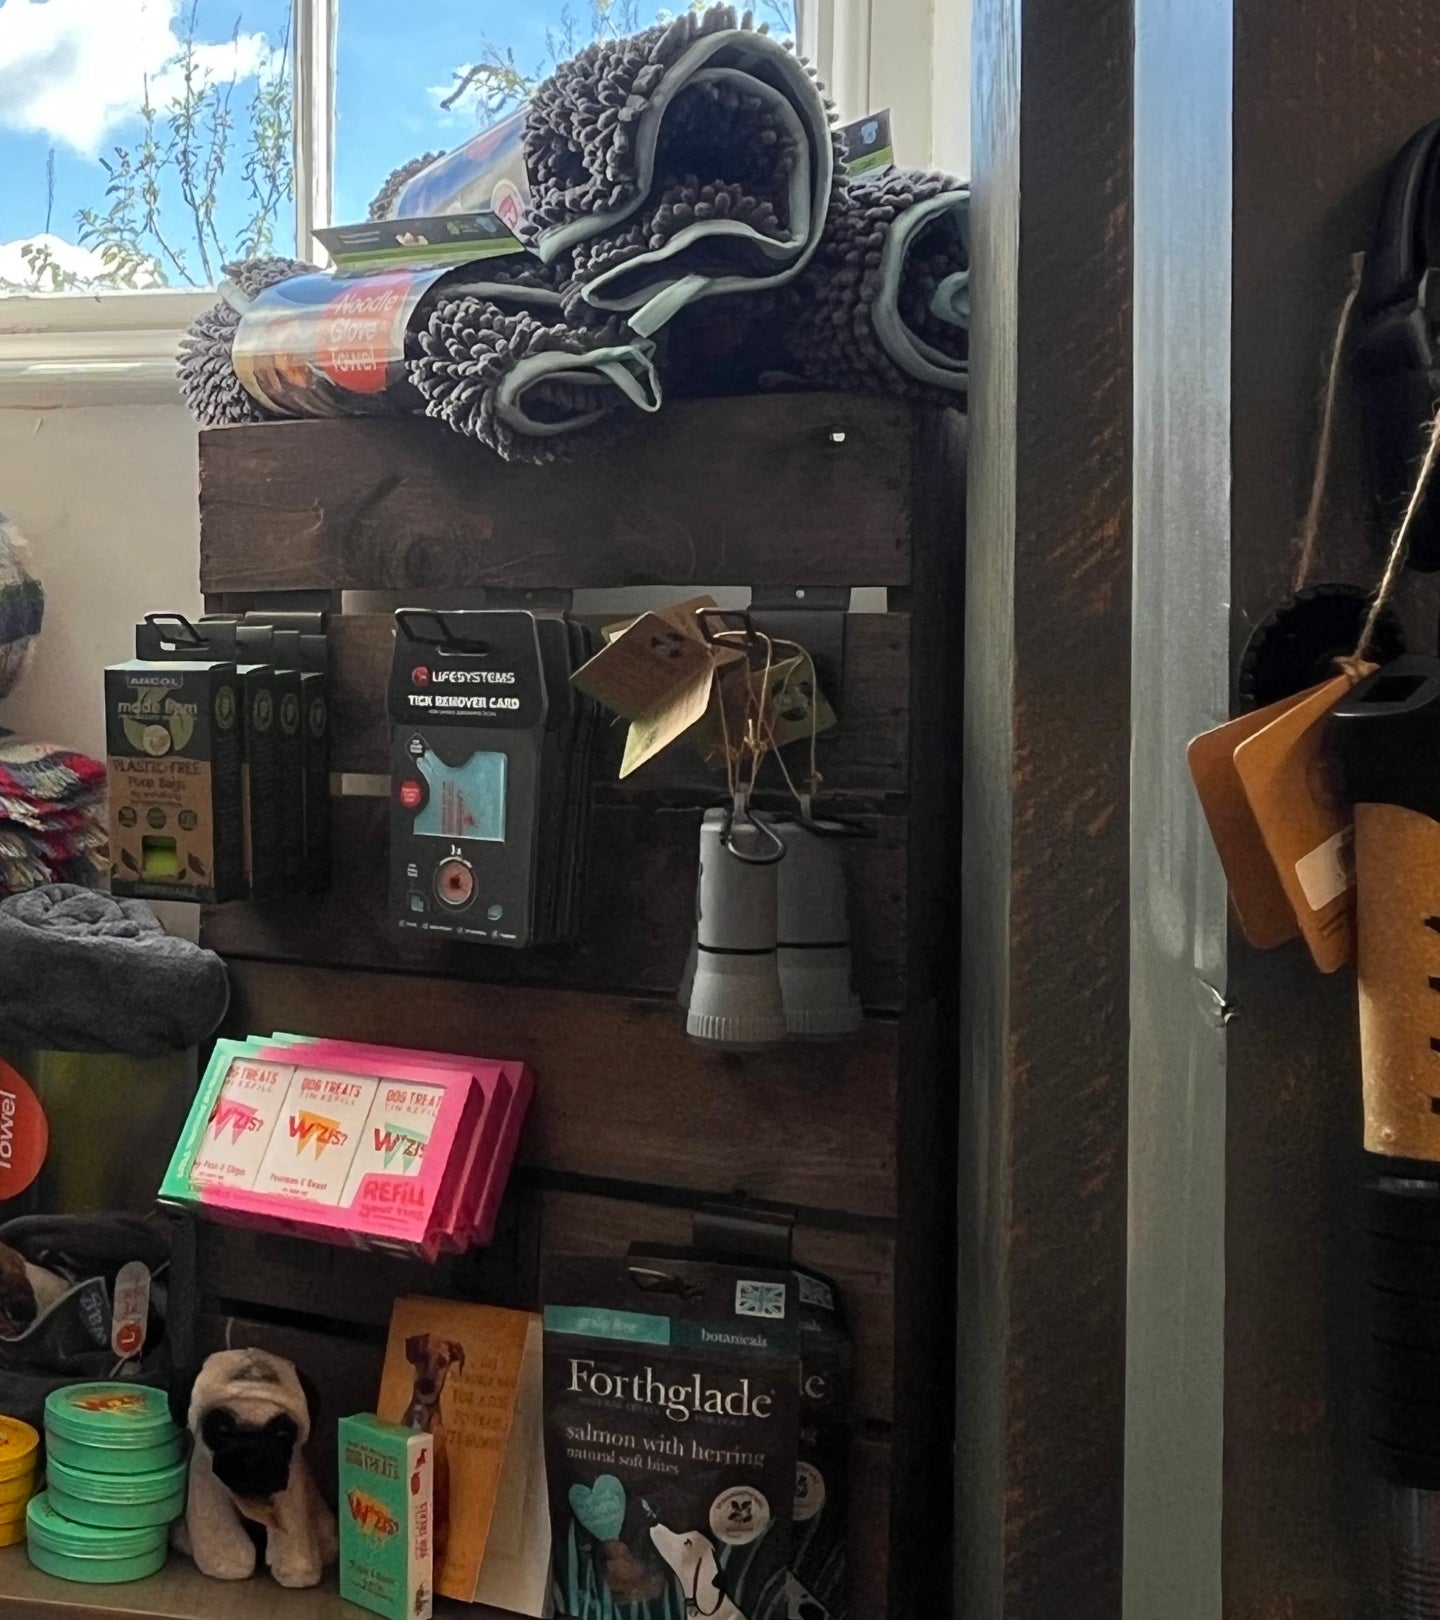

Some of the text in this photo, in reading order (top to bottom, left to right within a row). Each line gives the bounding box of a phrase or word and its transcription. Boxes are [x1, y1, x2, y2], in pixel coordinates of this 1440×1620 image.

[335, 290, 400, 315] Noodle
[432, 671, 516, 684] LIFESYSTEMS
[408, 694, 520, 710] TICK REMOVER CARD
[323, 1080, 363, 1098] TREATS
[409, 1092, 443, 1109] TREAT
[406, 1105, 437, 1118] REFIL
[701, 1328, 768, 1348] botanicals
[567, 1358, 771, 1422] Forthglade
[565, 1423, 767, 1467] salmon with herring
[566, 1447, 616, 1464] natural
[618, 1453, 643, 1467] soft
